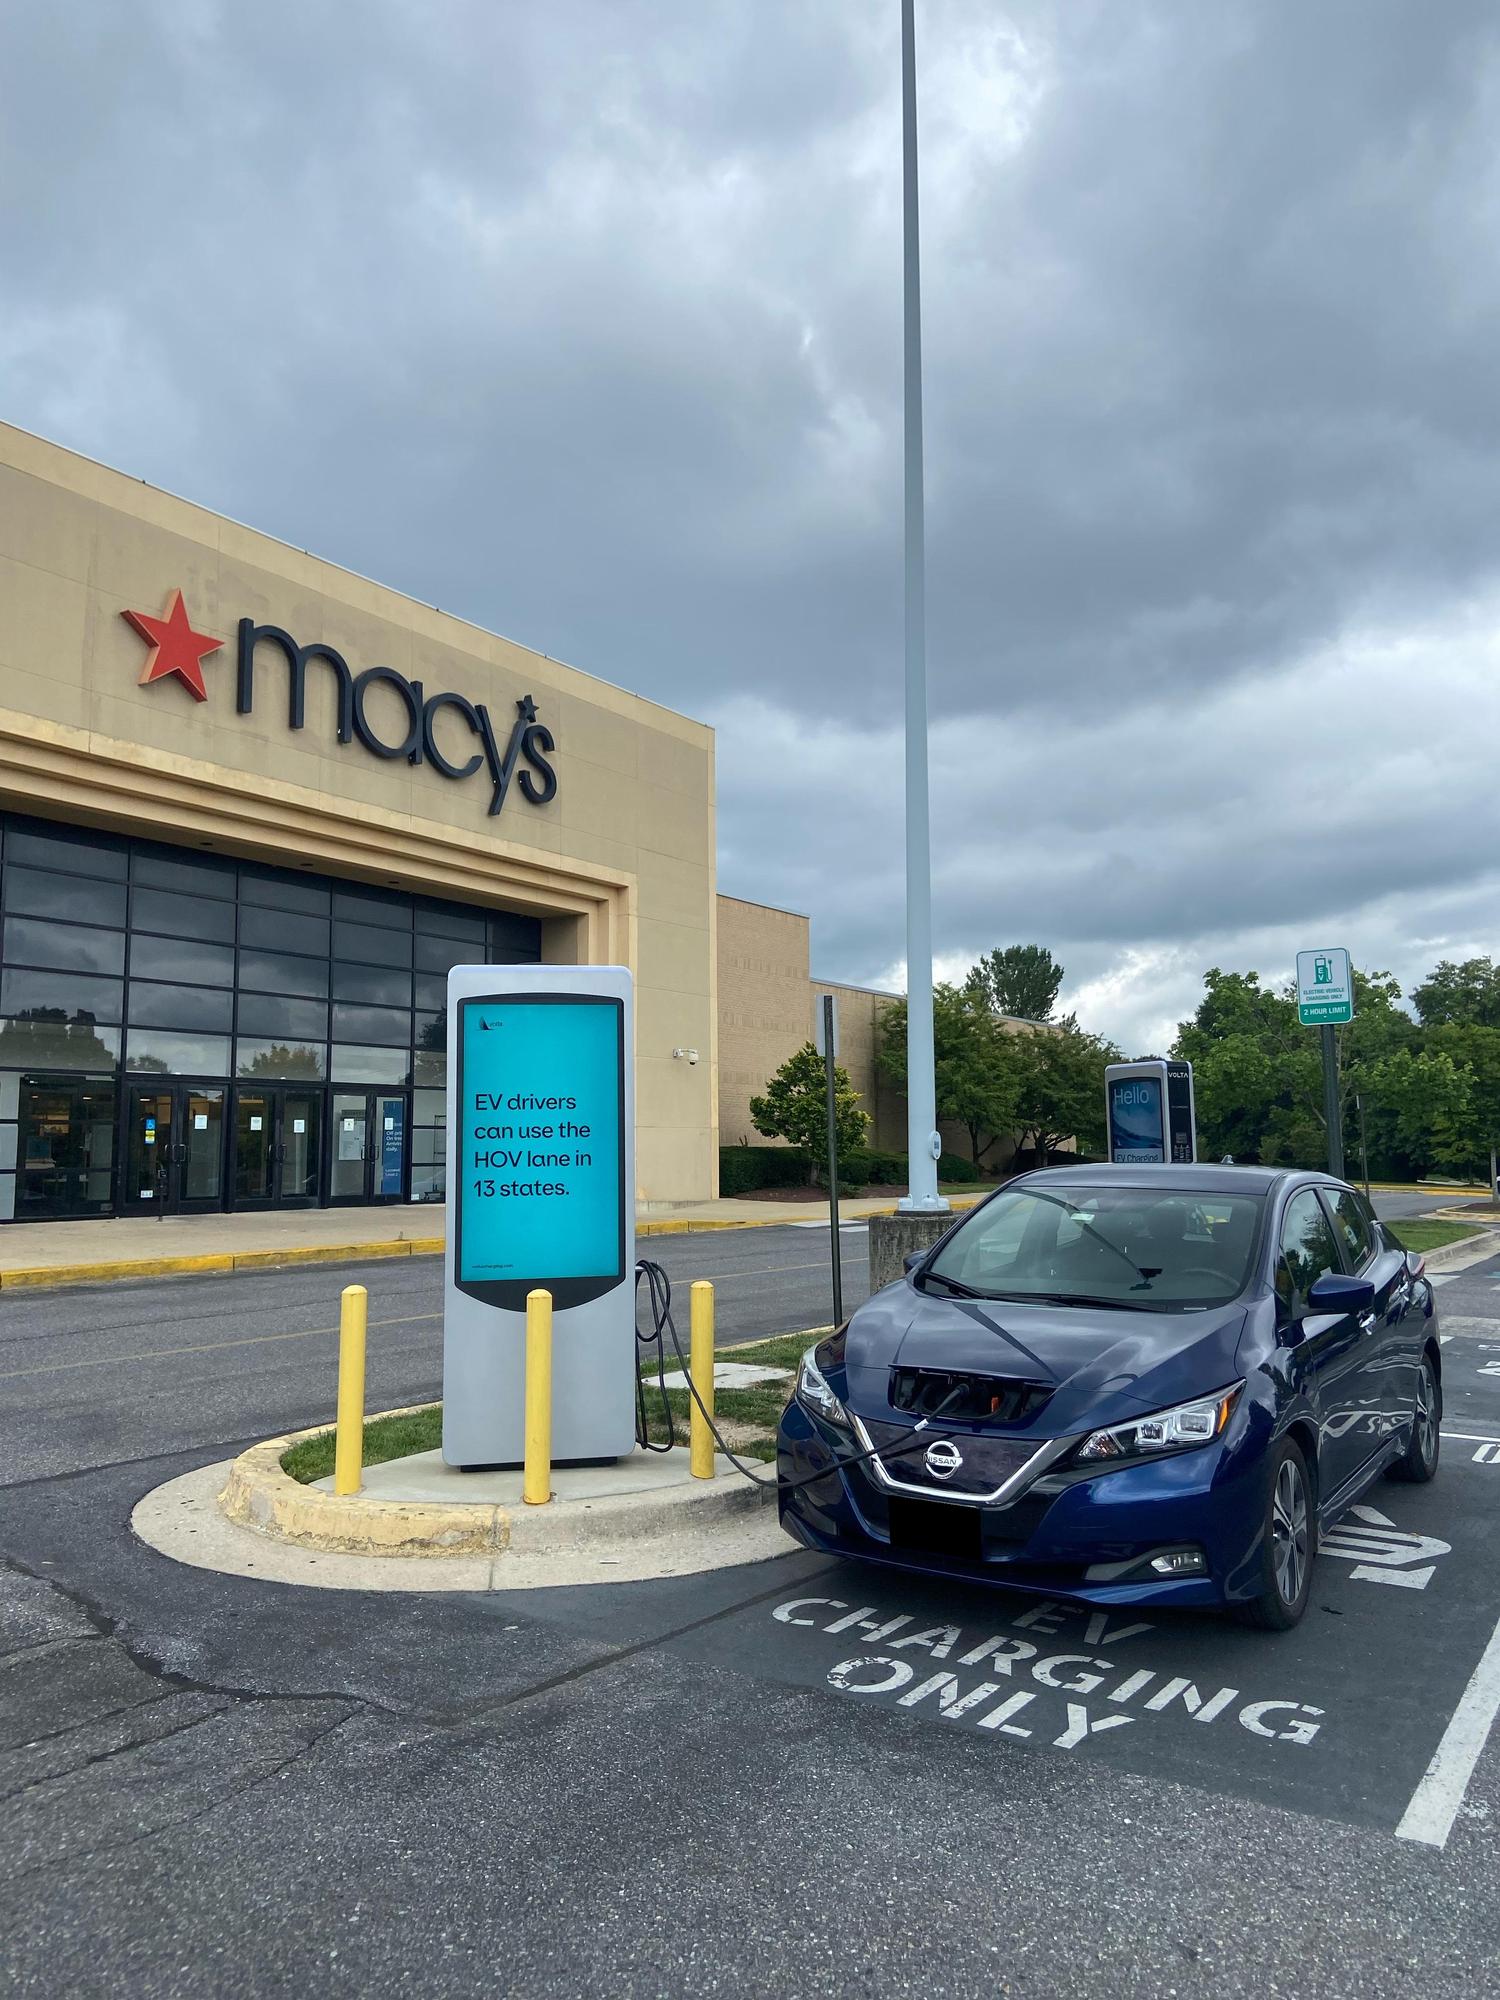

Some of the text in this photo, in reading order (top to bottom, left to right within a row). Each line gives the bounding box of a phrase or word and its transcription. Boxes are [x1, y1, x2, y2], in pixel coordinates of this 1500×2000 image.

[237, 618, 557, 816] macy's
[1303, 1008, 1309, 1016] 2
[1329, 1006, 1346, 1014] LIMIT
[475, 1093, 577, 1111] EV drivers
[1113, 1086, 1149, 1104] Hello
[474, 1121, 591, 1139] can use the
[474, 1149, 592, 1168] HOV lane in
[473, 1180, 570, 1197] 13 states.
[924, 1455, 957, 1465] NISSAN
[1012, 1602, 1156, 1646] EV
[771, 1597, 1326, 1745] CHARGING
[827, 1656, 1136, 1749] ONLY
